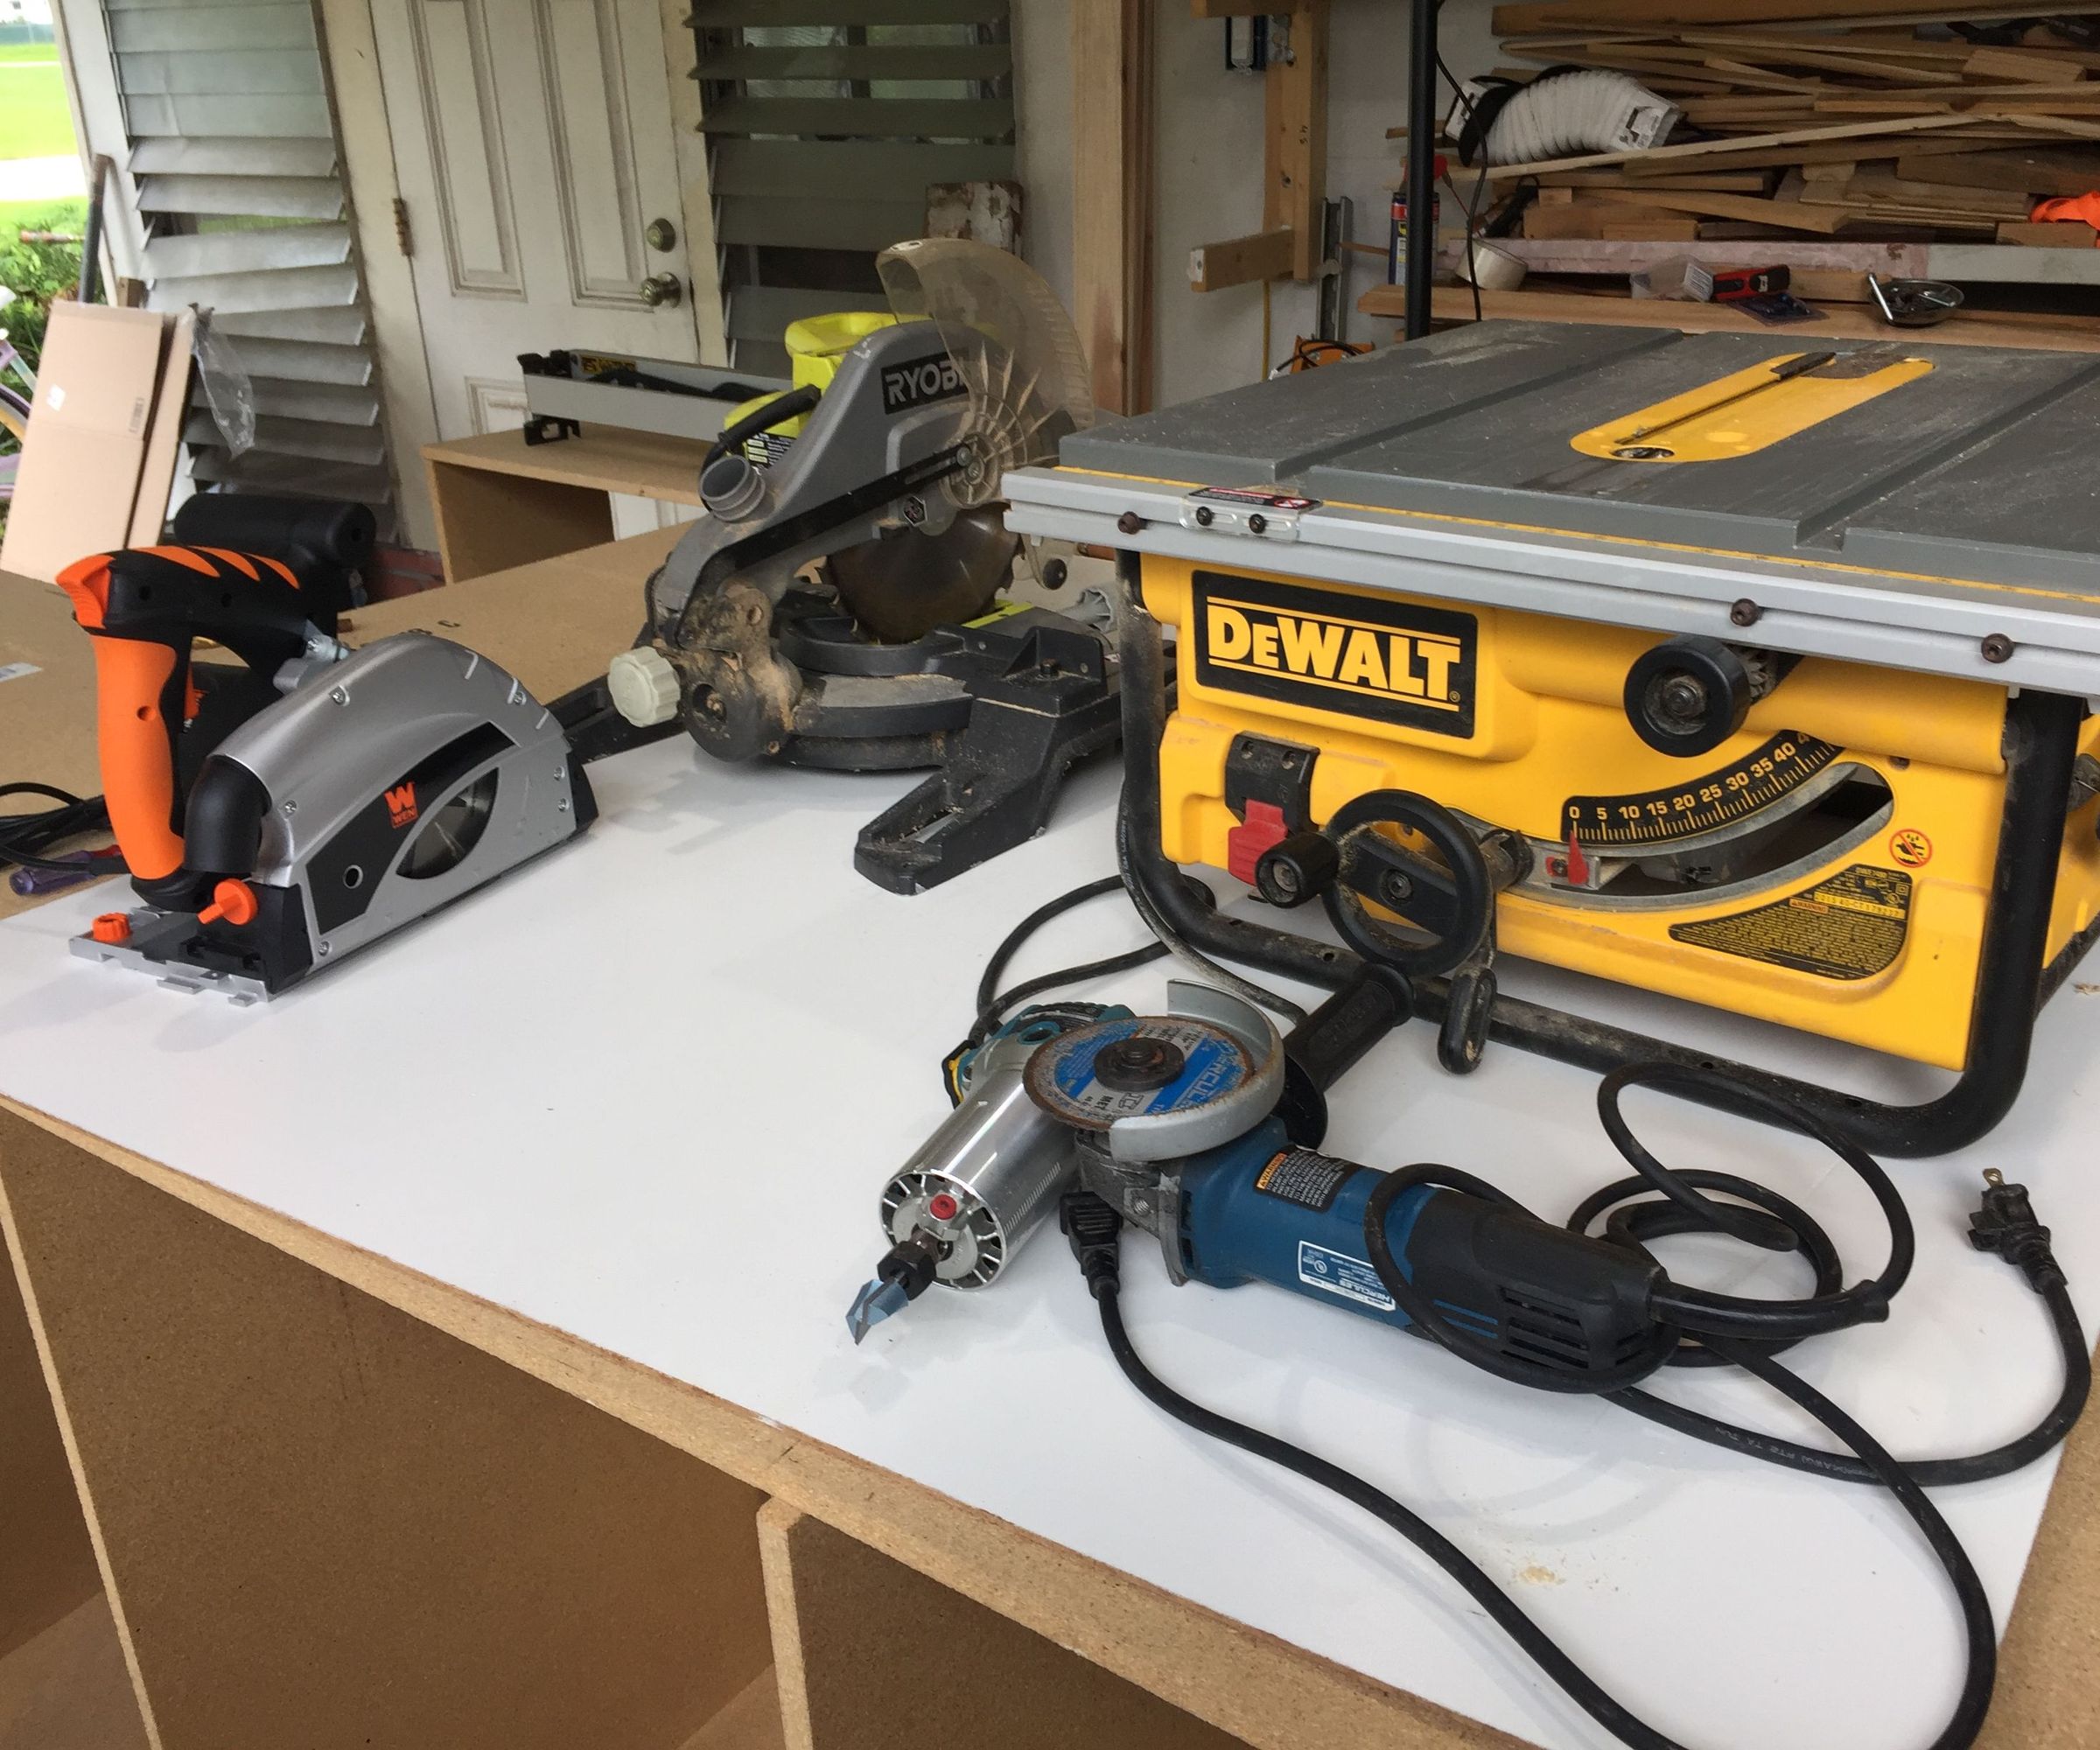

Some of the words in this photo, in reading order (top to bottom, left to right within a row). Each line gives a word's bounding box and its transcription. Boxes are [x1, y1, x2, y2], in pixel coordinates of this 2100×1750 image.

[1569, 806, 1580, 818] 0
[1597, 808, 1607, 820] 5
[1618, 805, 1641, 819] 10
[1646, 801, 1668, 816] 15
[1672, 794, 1696, 811] 20
[1699, 784, 1723, 802] 25
[1726, 772, 1749, 791] 30
[1750, 757, 1774, 778] 35
[1774, 742, 1796, 762] 40
[1339, 1278, 1391, 1302] HERCULES
